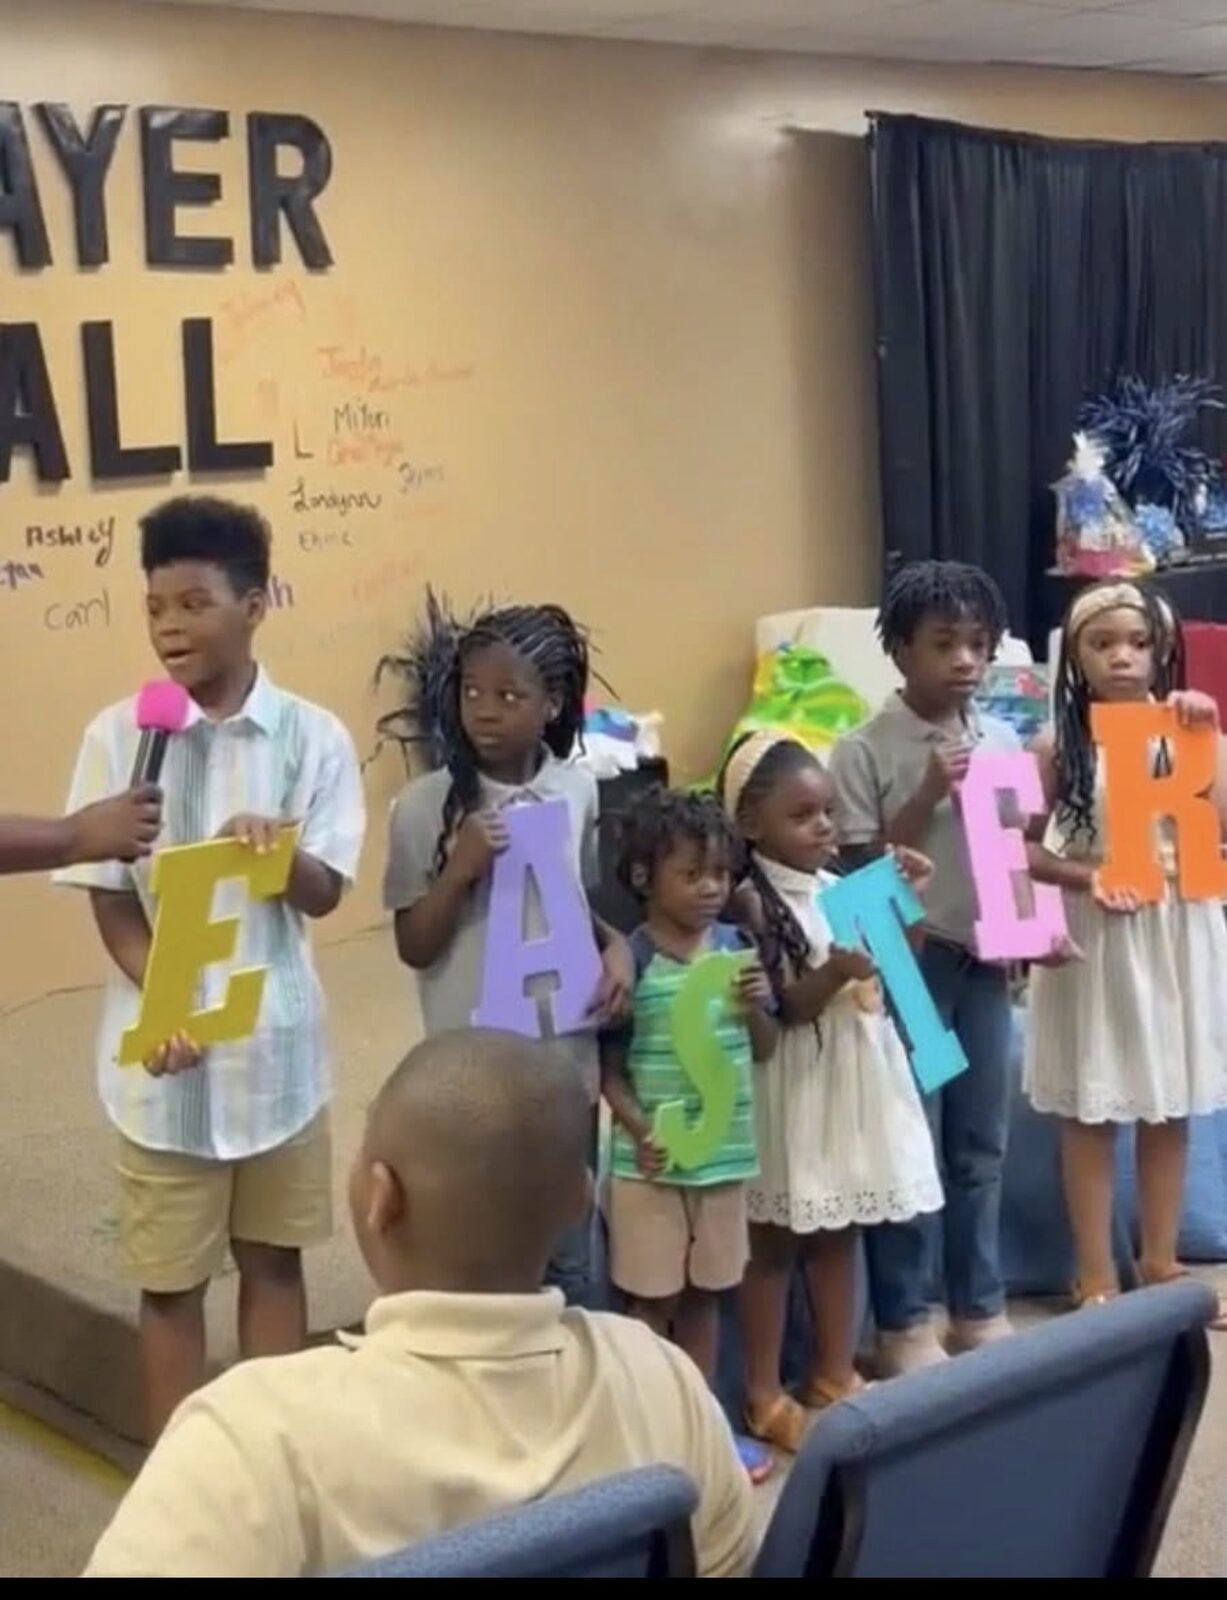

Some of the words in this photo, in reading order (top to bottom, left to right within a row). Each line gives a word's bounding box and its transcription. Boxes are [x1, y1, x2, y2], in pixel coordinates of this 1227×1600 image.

[0, 316, 274, 484] ALL
[117, 826, 299, 1067] E
[471, 800, 604, 1039] A
[655, 947, 757, 1171] S
[815, 853, 969, 1096] T
[957, 750, 1066, 962] E
[1091, 703, 1227, 904] R
